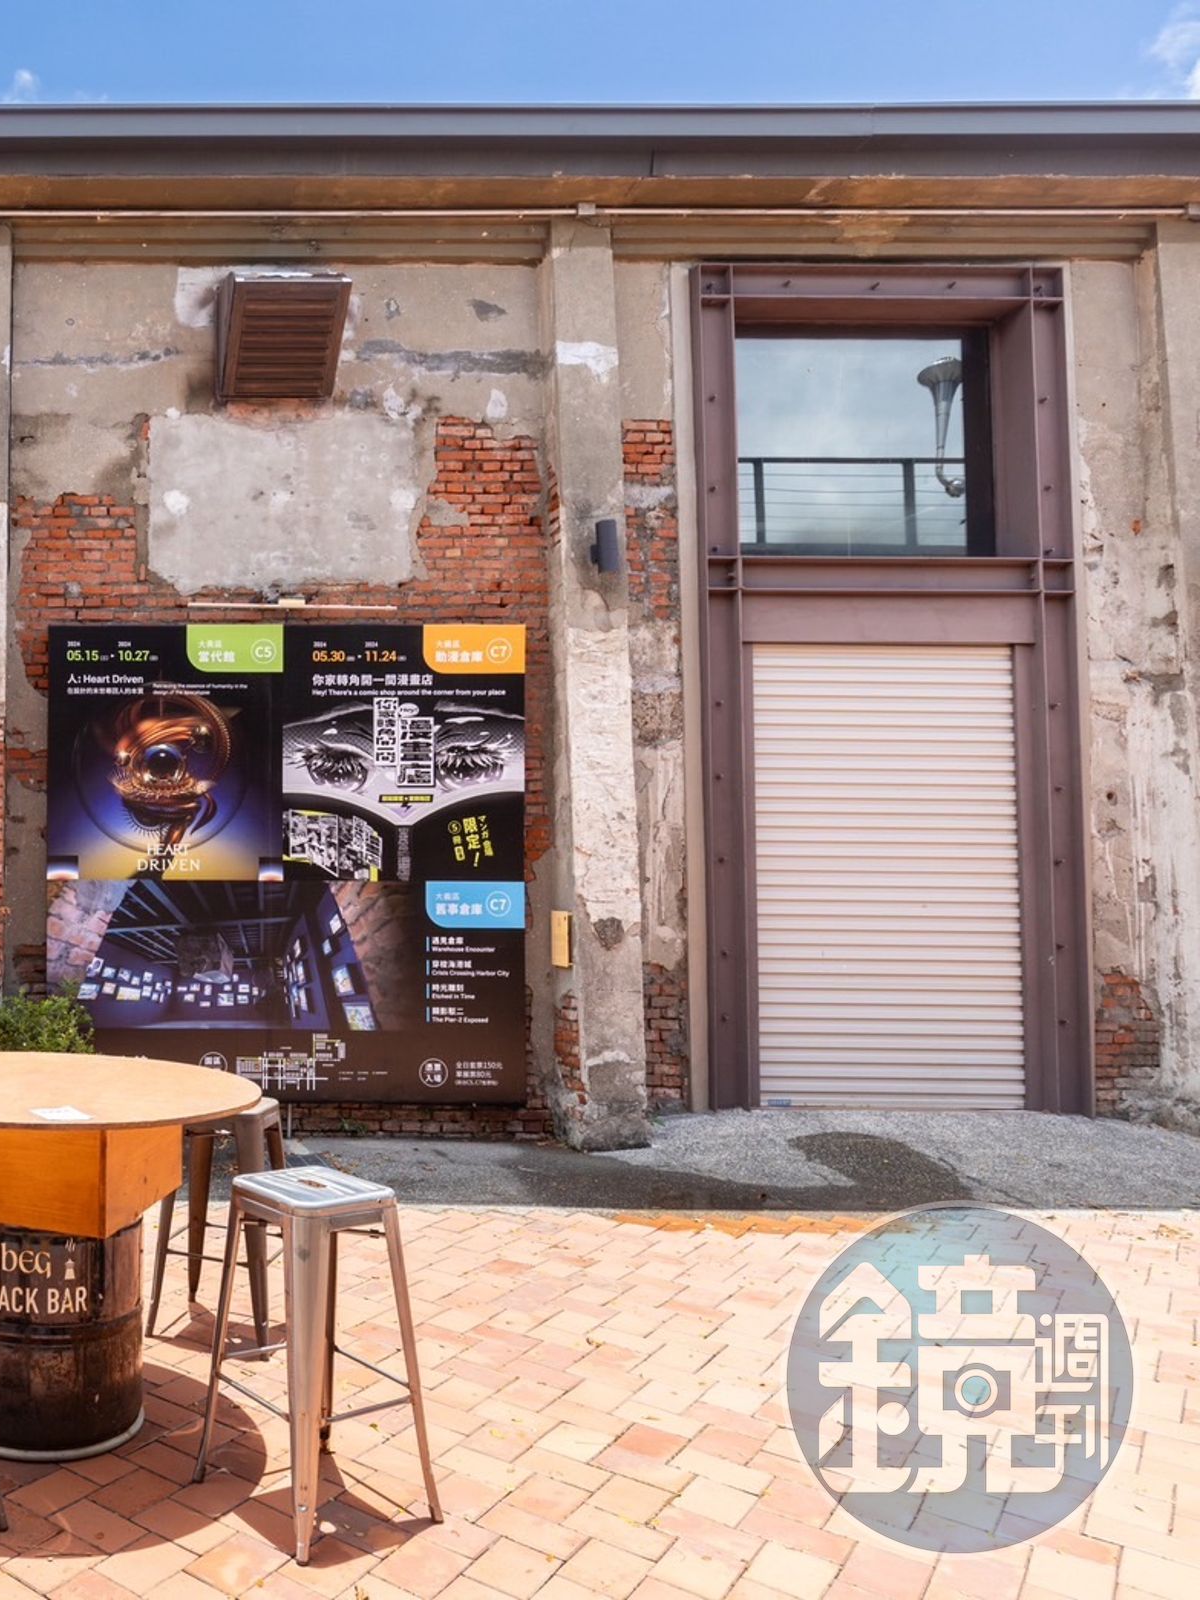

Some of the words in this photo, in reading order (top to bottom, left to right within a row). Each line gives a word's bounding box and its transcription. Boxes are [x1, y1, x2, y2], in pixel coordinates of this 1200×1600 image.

[66, 650, 99, 661] 05.15
[118, 650, 150, 661] 10.27
[254, 646, 273, 658] C5
[312, 650, 345, 662] 05.30
[365, 650, 397, 662] 11.24
[489, 645, 508, 658] C7
[83, 674, 110, 684] Heart
[112, 674, 144, 684] Driven
[312, 674, 433, 687] 你家轉角開一間漫畫店
[380, 689, 396, 697] shop
[487, 689, 506, 697] place
[147, 843, 190, 856] HEART
[136, 859, 200, 871] DRIVEN
[489, 899, 507, 911] C7
[47, 1285, 88, 1315] BAR
